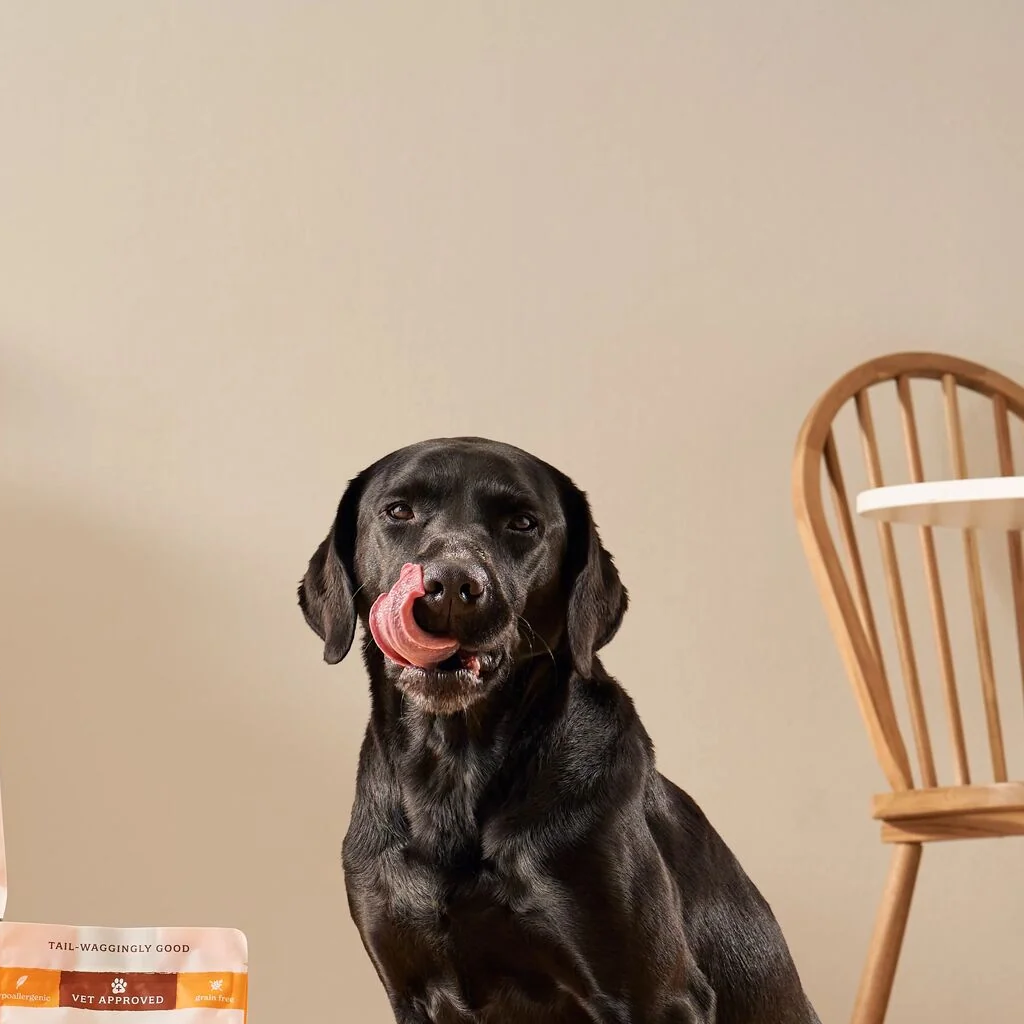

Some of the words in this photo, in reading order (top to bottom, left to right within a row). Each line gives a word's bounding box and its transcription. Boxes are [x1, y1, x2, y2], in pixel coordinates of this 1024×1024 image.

[48, 941, 152, 953] TAIL-WAGGINGLY
[156, 944, 190, 953] GOOD
[72, 994, 94, 1004] VET
[98, 995, 164, 1005] APPROVED
[195, 994, 216, 1003] grain
[218, 995, 234, 1003] free
